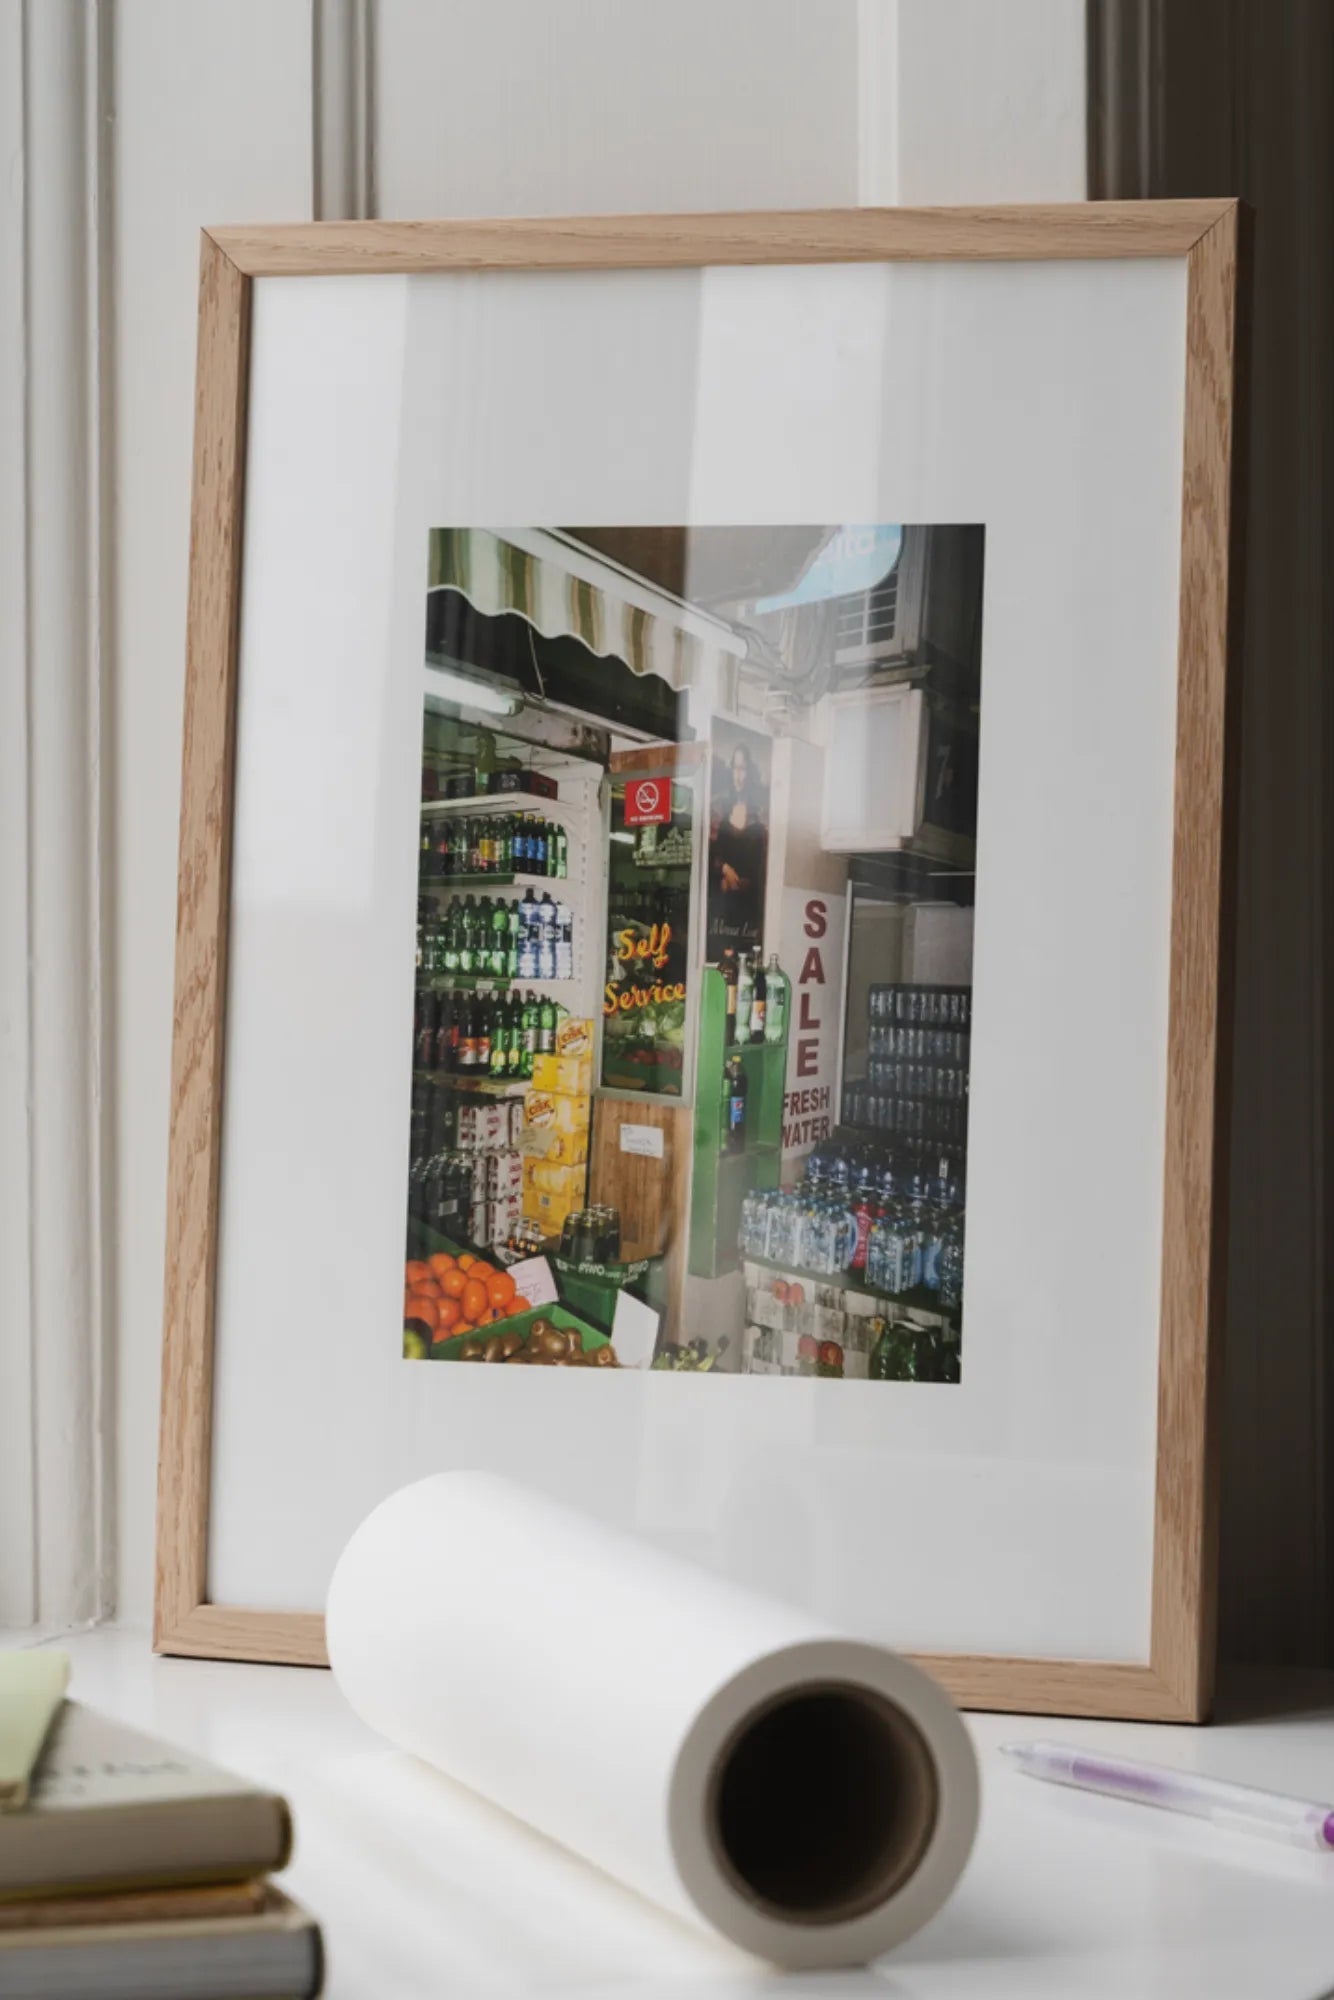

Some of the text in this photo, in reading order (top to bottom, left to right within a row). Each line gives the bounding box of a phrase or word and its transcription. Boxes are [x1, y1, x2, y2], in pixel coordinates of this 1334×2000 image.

[618, 922, 671, 969] Self
[602, 978, 687, 1015] Service
[797, 899, 828, 1078] SALE
[783, 1085, 831, 1117] FRESH
